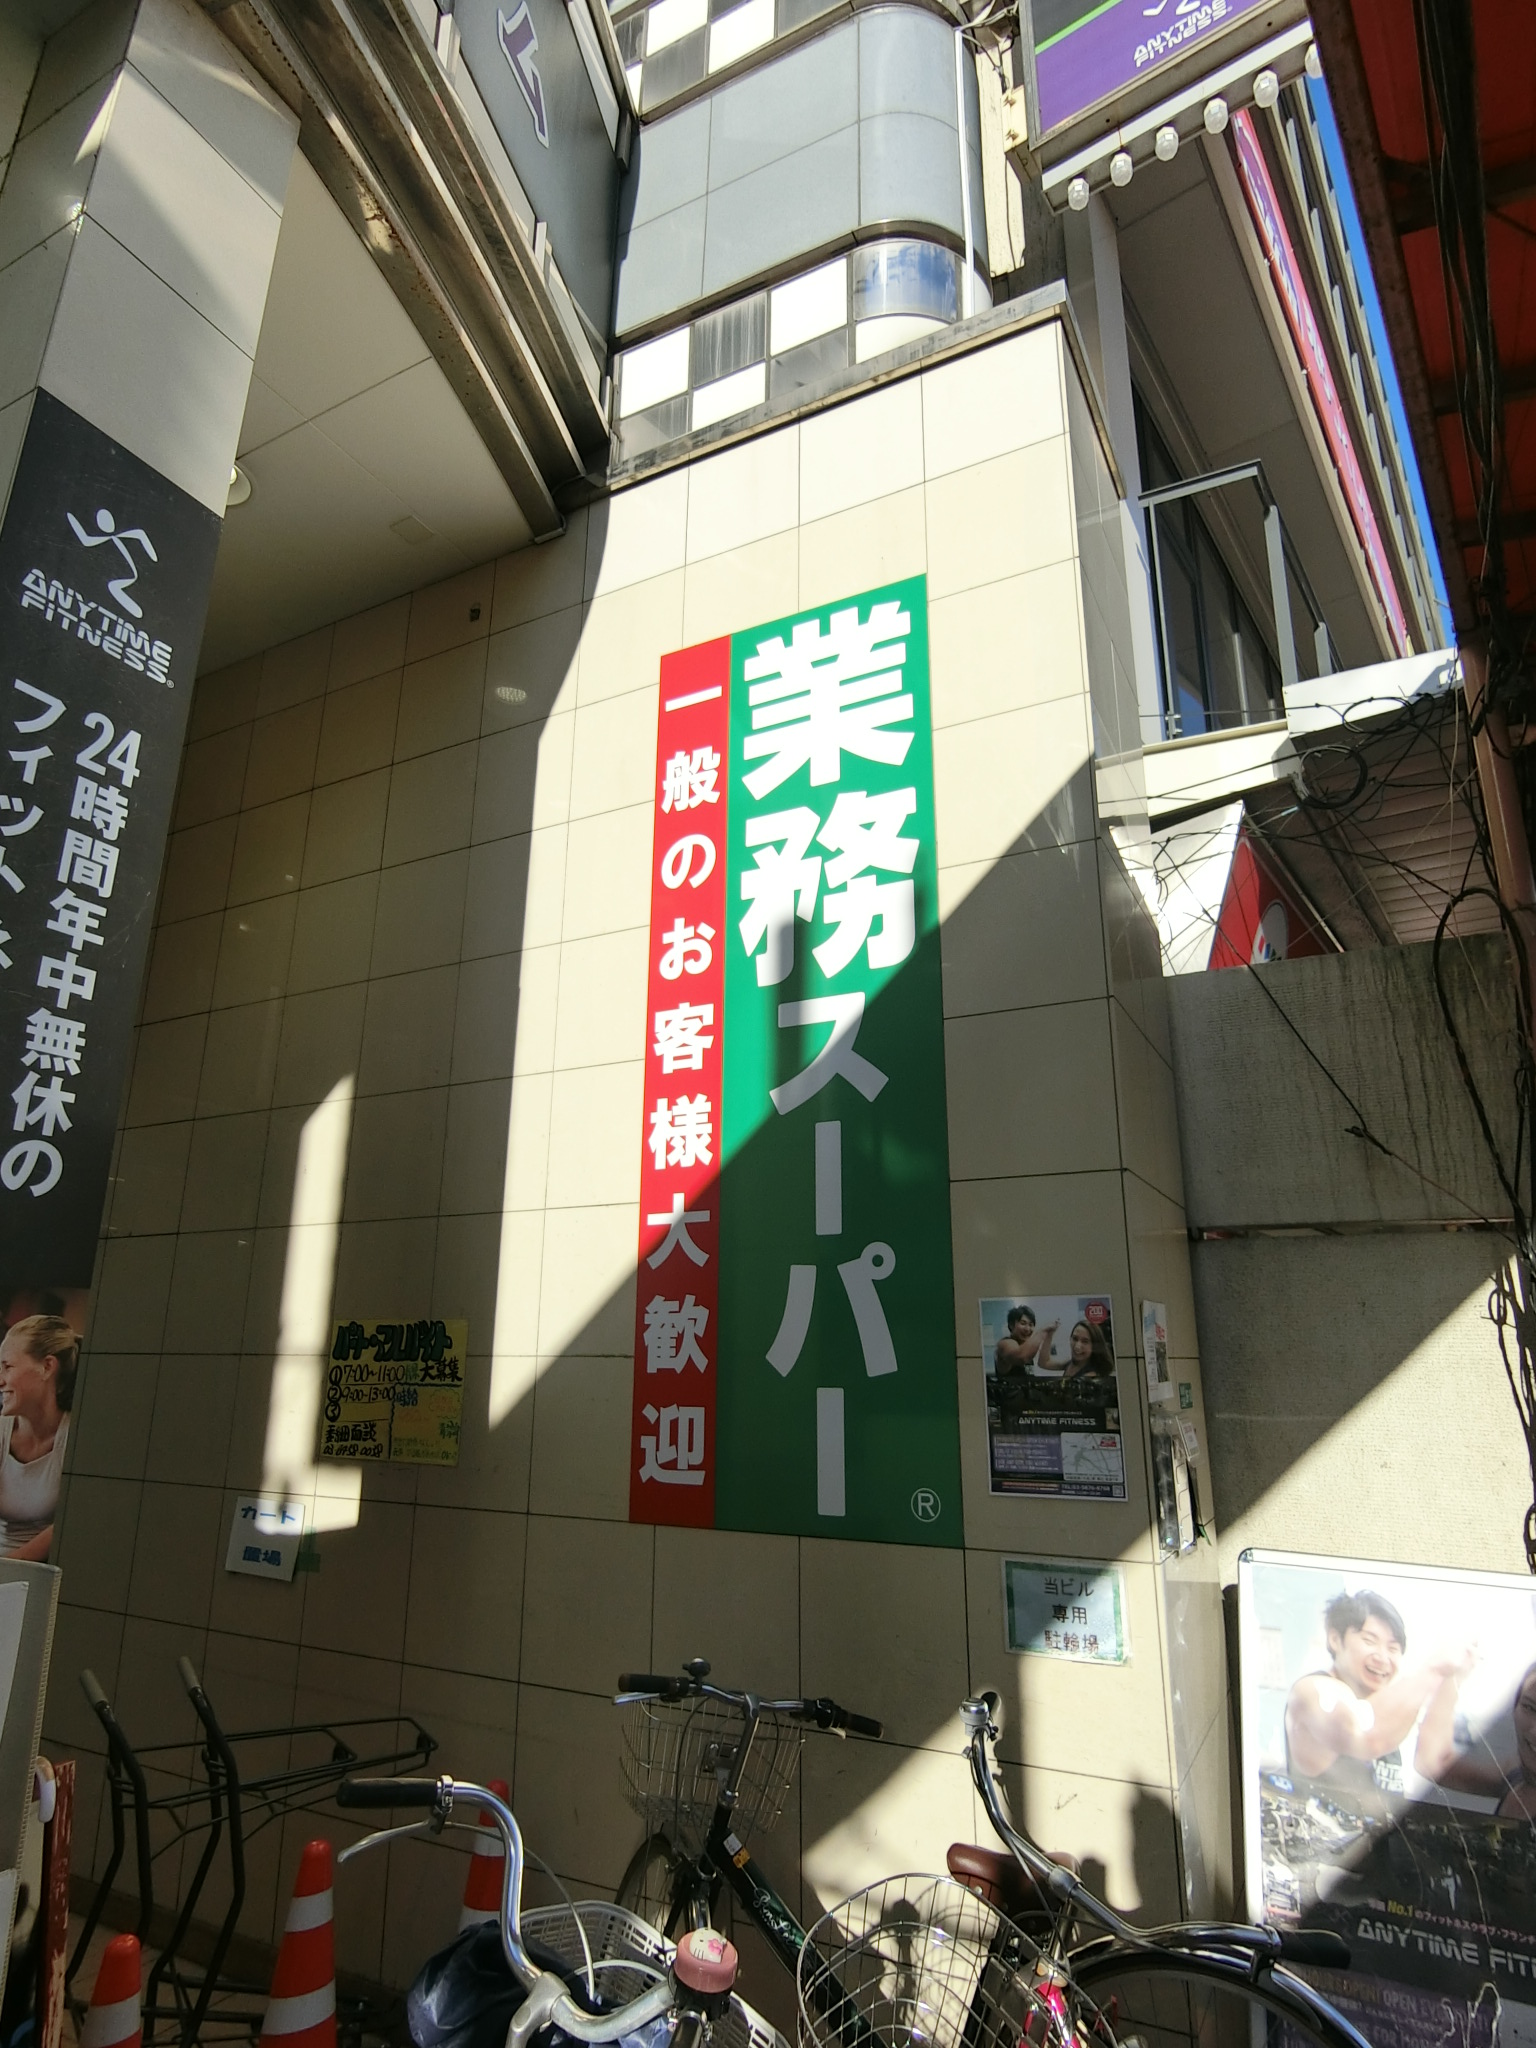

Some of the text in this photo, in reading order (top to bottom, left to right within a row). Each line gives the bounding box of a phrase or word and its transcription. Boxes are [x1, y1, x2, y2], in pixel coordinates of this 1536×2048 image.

[1134, 0, 1227, 61] ANYTIME
[1136, 8, 1227, 68] FITNESS
[22, 568, 173, 668] ANYTIME
[0, 711, 142, 1197] 24時間年中無休の
[738, 600, 921, 1517] 業務スーパー
[638, 685, 722, 1486] 一般のお客様大歓迎
[420, 1356, 463, 1382] 大募集
[1018, 1416, 1096, 1426] ANYTIME FITNESS
[241, 1505, 296, 1525] カート
[242, 1546, 282, 1567] 置場
[1044, 1576, 1095, 1597] 当ビル
[1052, 1603, 1089, 1625] 専用
[1044, 1630, 1100, 1655] 駐輪場
[1356, 1917, 1536, 1979] ANYTIME FIT
